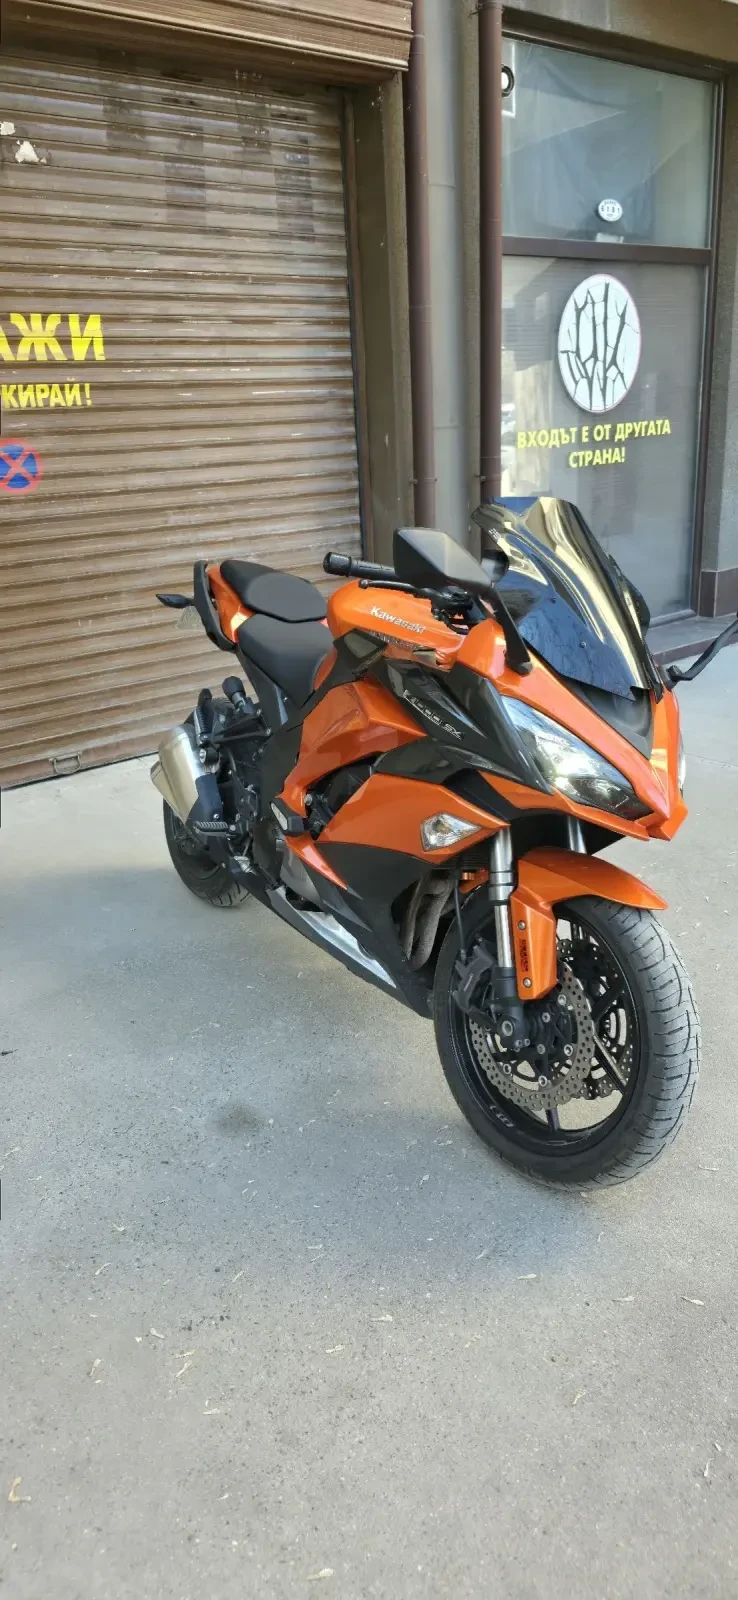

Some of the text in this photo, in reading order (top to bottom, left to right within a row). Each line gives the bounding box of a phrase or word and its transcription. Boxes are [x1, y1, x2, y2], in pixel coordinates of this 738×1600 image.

[517, 419, 671, 448] ВХОДЪТ Е ОТ ДРУГАТА
[569, 446, 625, 468] СТРАНА!
[370, 606, 426, 634] Kawasaki
